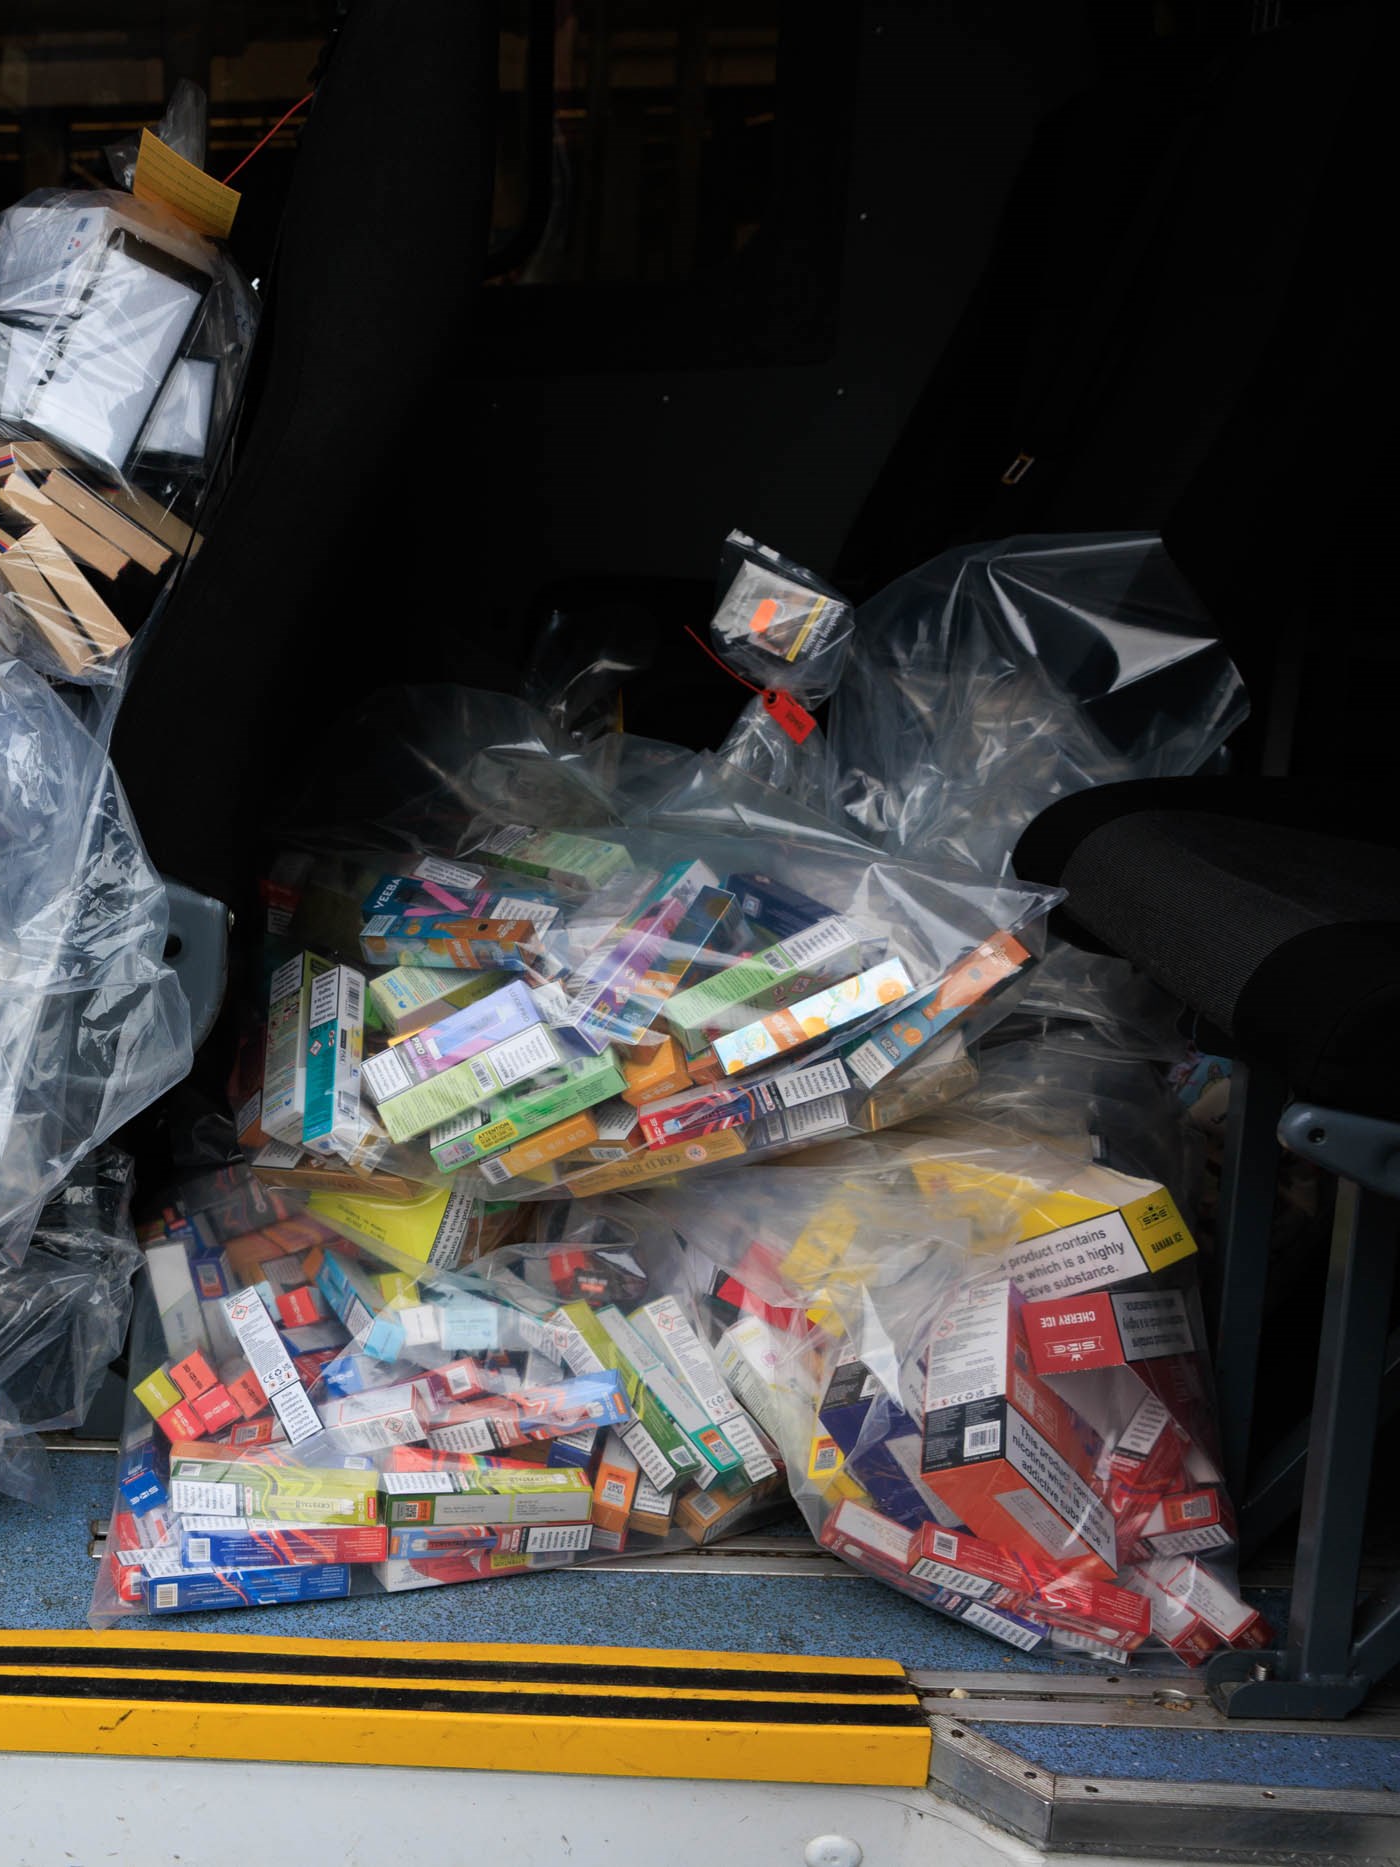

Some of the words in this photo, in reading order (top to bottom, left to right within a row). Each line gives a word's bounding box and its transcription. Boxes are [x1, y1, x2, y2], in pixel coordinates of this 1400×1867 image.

[373, 877, 403, 910] VEEBA
[410, 1036, 426, 1056] PRO
[789, 1078, 800, 1100] product
[476, 1120, 511, 1140] ATTENTION
[1008, 1245, 1053, 1270] product
[1055, 1228, 1108, 1252] contains
[1150, 1235, 1175, 1254] BANANA
[1172, 1231, 1185, 1243] ICE
[1026, 1262, 1063, 1282] which
[1062, 1256, 1076, 1268] is
[1076, 1255, 1086, 1265] a
[1086, 1241, 1125, 1263] highly
[1053, 1264, 1120, 1292] substance.
[1040, 1316, 1058, 1330] ICE
[1057, 1309, 1097, 1327] CHERRY
[1019, 1422, 1039, 1450] This
[1039, 1447, 1071, 1482] product
[1012, 1435, 1046, 1473] nicotine
[1087, 1511, 1112, 1545] highly
[1021, 1459, 1060, 1503] addictive
